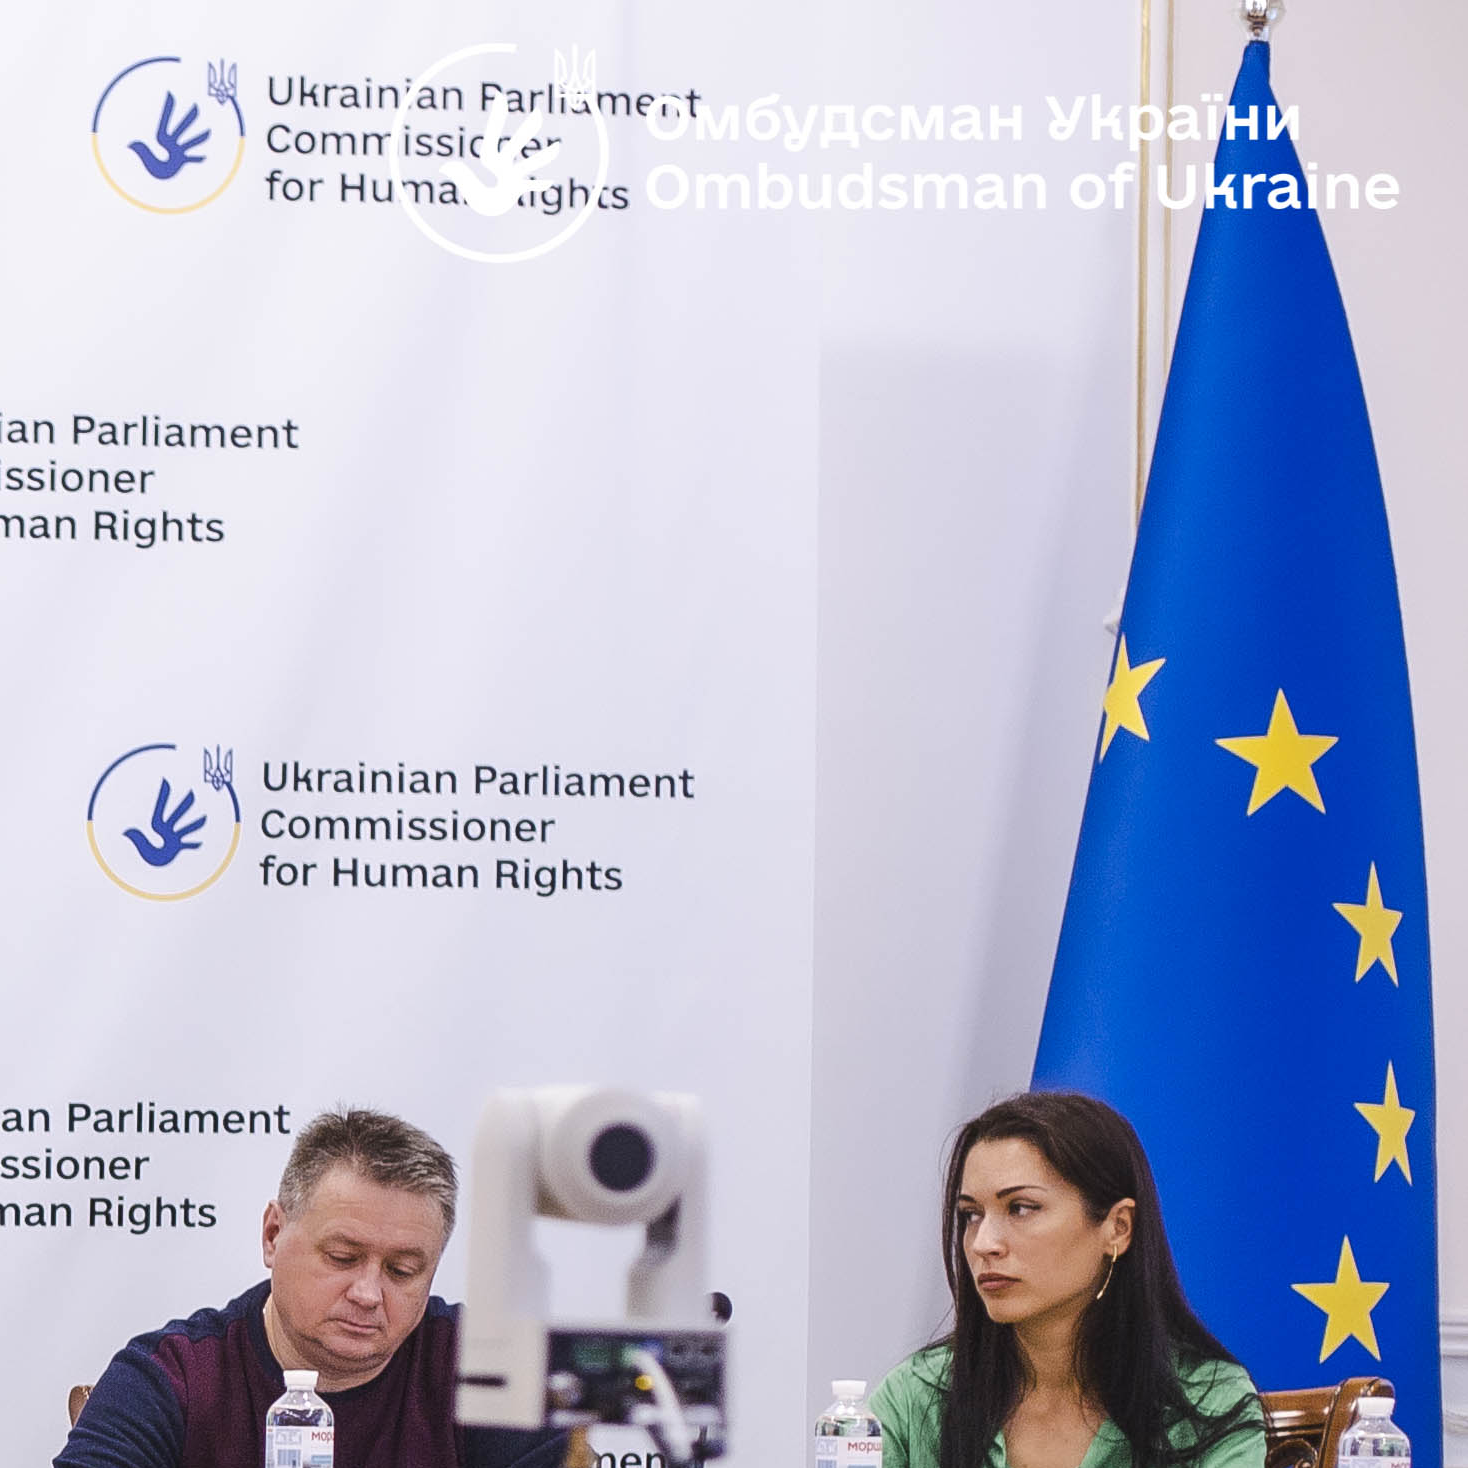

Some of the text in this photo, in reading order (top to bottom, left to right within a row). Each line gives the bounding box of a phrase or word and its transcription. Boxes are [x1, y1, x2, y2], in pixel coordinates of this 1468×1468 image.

[268, 76, 463, 111] Ukrainian
[266, 170, 628, 215] for Huma ights
[74, 416, 298, 449] Parliament
[95, 510, 224, 549] Rights
[264, 761, 695, 798] Ukrainian Parliament
[261, 809, 556, 842] Commissioner
[259, 855, 623, 897] for Human Rights
[69, 1102, 291, 1134] Parliament
[89, 1196, 217, 1235] Rights
